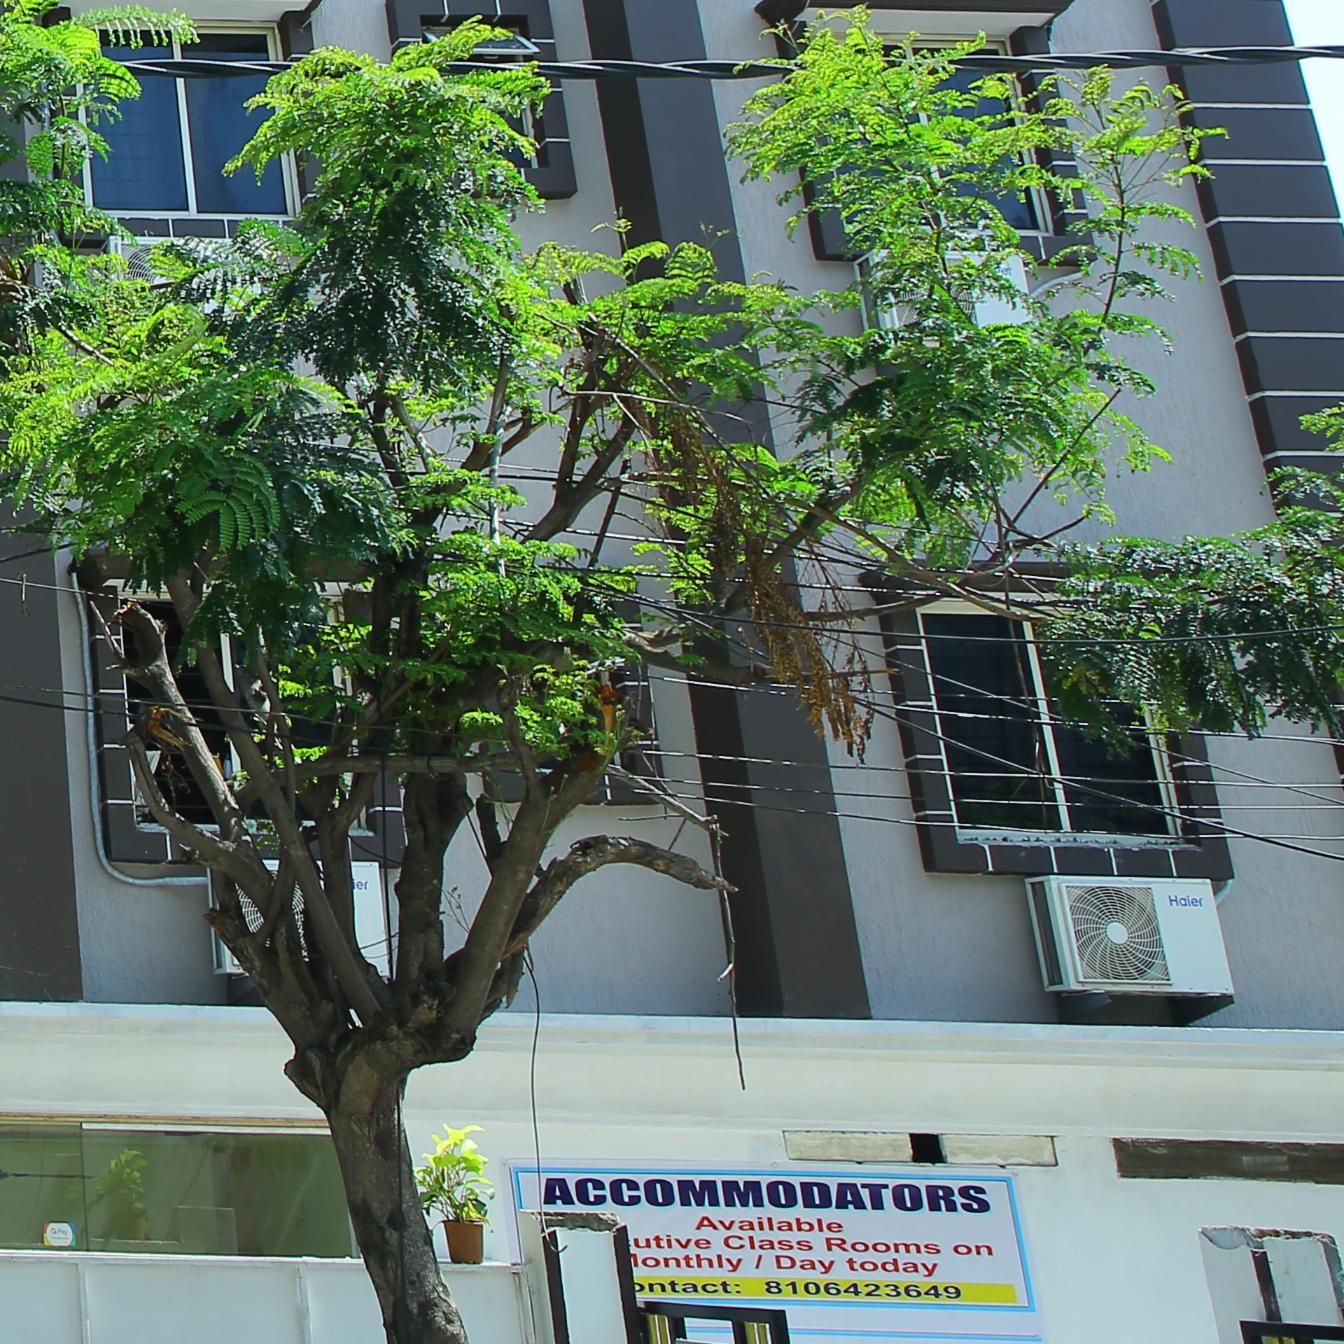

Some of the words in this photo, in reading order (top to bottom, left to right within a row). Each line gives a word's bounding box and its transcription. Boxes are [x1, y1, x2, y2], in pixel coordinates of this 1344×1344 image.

[1168, 895, 1204, 907] Haier
[543, 1177, 991, 1214] ACCOMMODATORS
[695, 1215, 844, 1233] Available
[628, 1235, 712, 1250] utive
[723, 1235, 813, 1252] Class
[824, 1236, 941, 1255] Rooms
[952, 1243, 993, 1257] on
[754, 1254, 763, 1270] /
[775, 1255, 835, 1275] Day
[846, 1257, 939, 1277] today
[632, 1279, 741, 1295] ontact:
[764, 1280, 962, 1300] 8106423649
